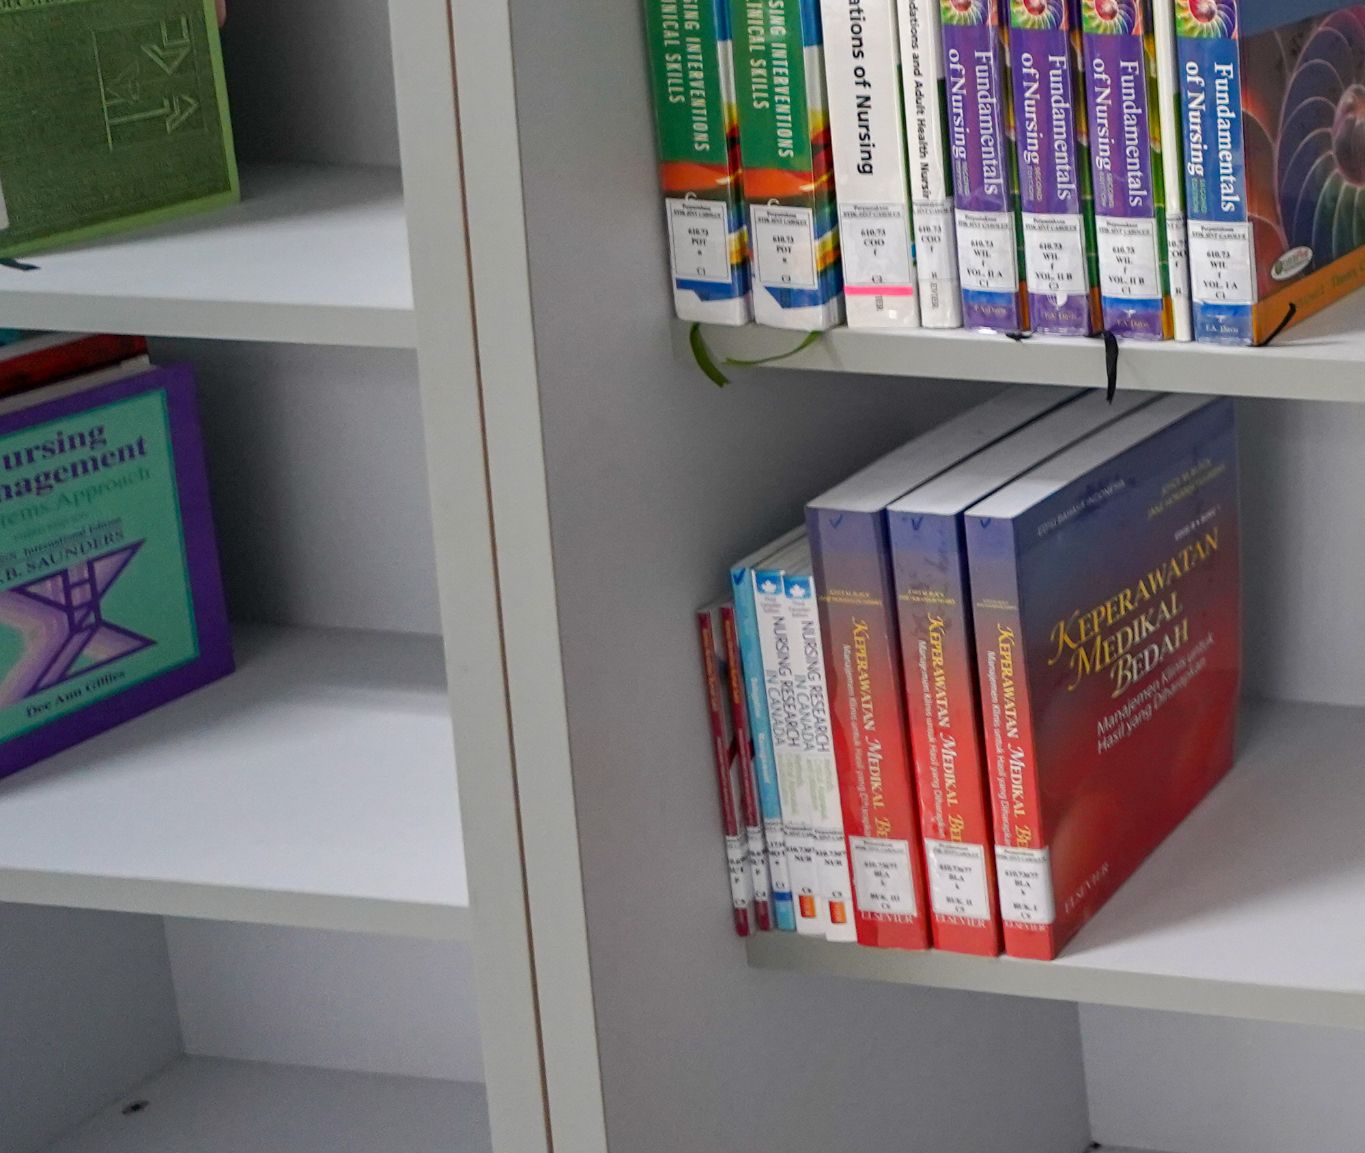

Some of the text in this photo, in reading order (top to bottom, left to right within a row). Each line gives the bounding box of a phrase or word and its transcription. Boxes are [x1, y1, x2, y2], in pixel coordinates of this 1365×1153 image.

[665, 53, 685, 103] SKILLS
[685, 37, 710, 152] INTERVENTIONS
[853, 65, 867, 87] of
[949, 49, 971, 160] of Nursing
[974, 50, 999, 195] Fundamentals
[1021, 53, 1043, 164] of Nursing
[1048, 55, 1077, 201] Fundamentals
[1093, 59, 1115, 172] of Nursing
[1185, 62, 1208, 177] of Nursing
[852, 91, 874, 176] Nursing
[1120, 60, 1148, 208] Fundamentals
[1214, 62, 1236, 212] Fundamentals
[801, 620, 821, 683] NURSING
[1048, 526, 1221, 666] KEPERAWATAN
[1068, 591, 1183, 692] MEDIKAL
[928, 612, 959, 807] KEPERAWATAN MEDIKAL
[1110, 618, 1189, 698] BEDAH
[810, 684, 829, 751] RESEARCH
[998, 623, 1019, 738] KEPERAWATAN
[1009, 745, 1026, 817] MEDIKAL
